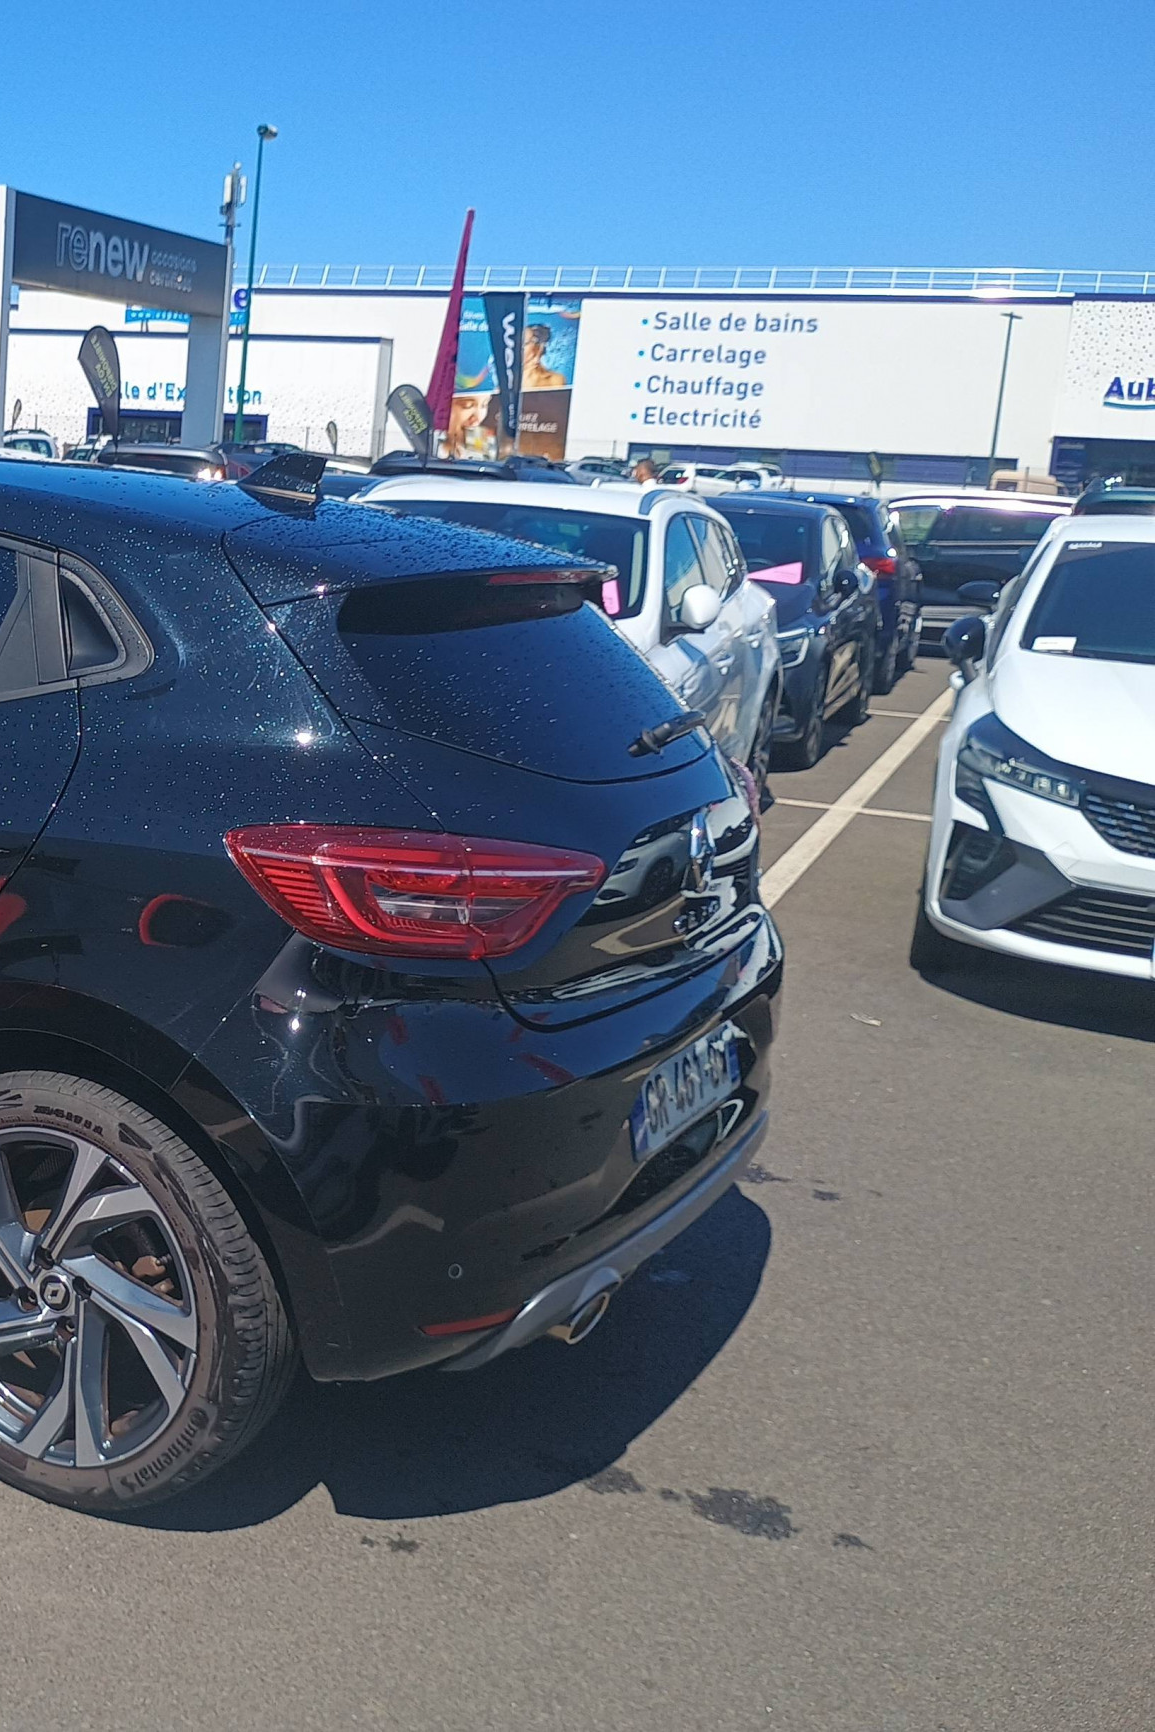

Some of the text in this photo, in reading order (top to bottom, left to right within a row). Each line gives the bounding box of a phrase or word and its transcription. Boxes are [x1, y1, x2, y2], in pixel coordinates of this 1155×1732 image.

[55, 222, 149, 282] renew
[653, 312, 818, 333] Salle de bains
[650, 343, 767, 368] Carrelage
[646, 375, 764, 401] Chauffage
[643, 406, 763, 429] Electricité
